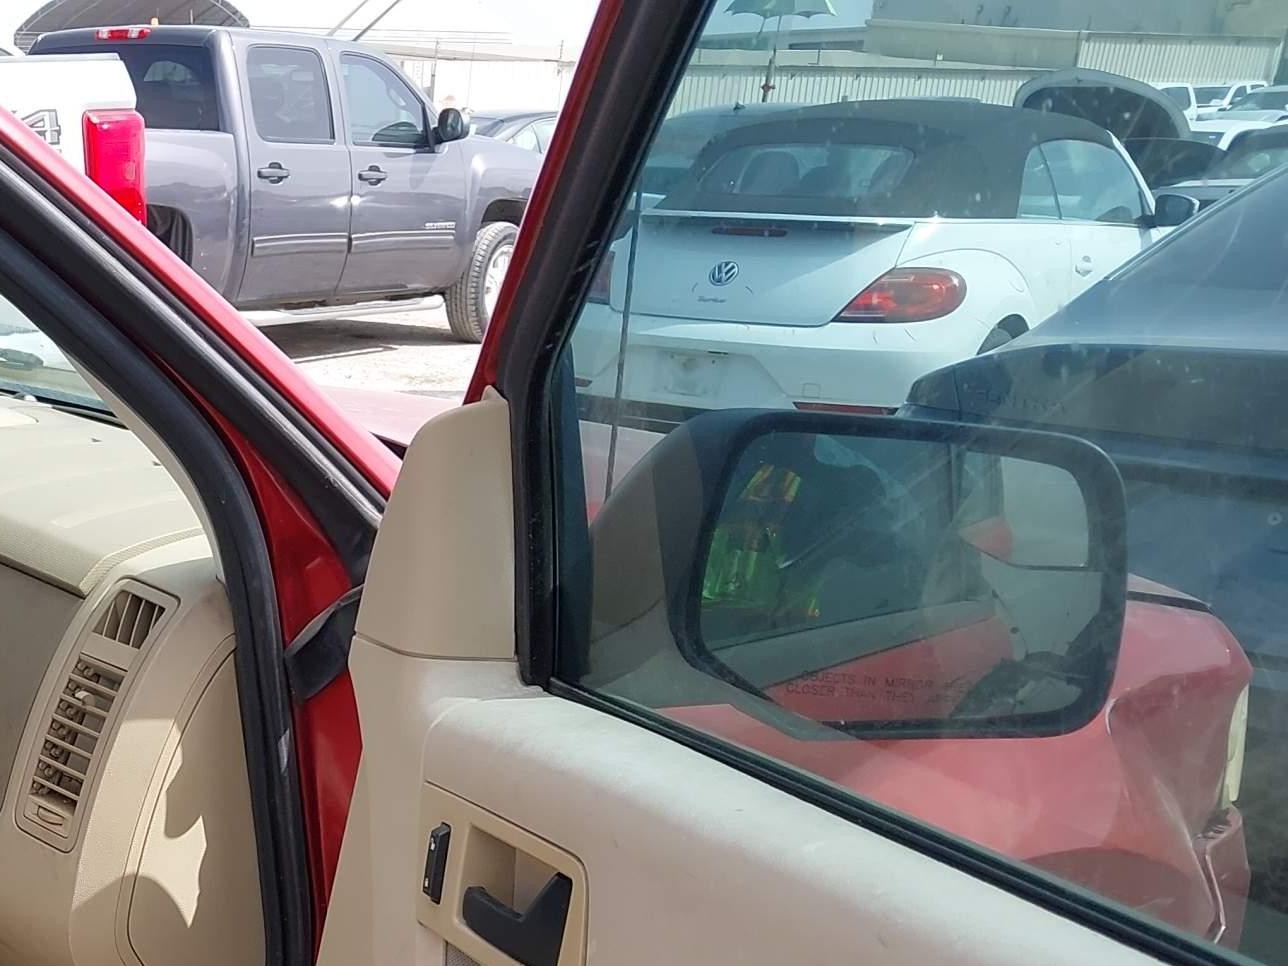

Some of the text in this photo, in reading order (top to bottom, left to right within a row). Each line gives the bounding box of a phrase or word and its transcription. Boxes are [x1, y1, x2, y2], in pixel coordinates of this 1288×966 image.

[801, 671, 856, 686] OBJECTS
[862, 675, 876, 687] IN
[885, 677, 934, 690] MIRROR
[785, 683, 835, 698] CLOSER
